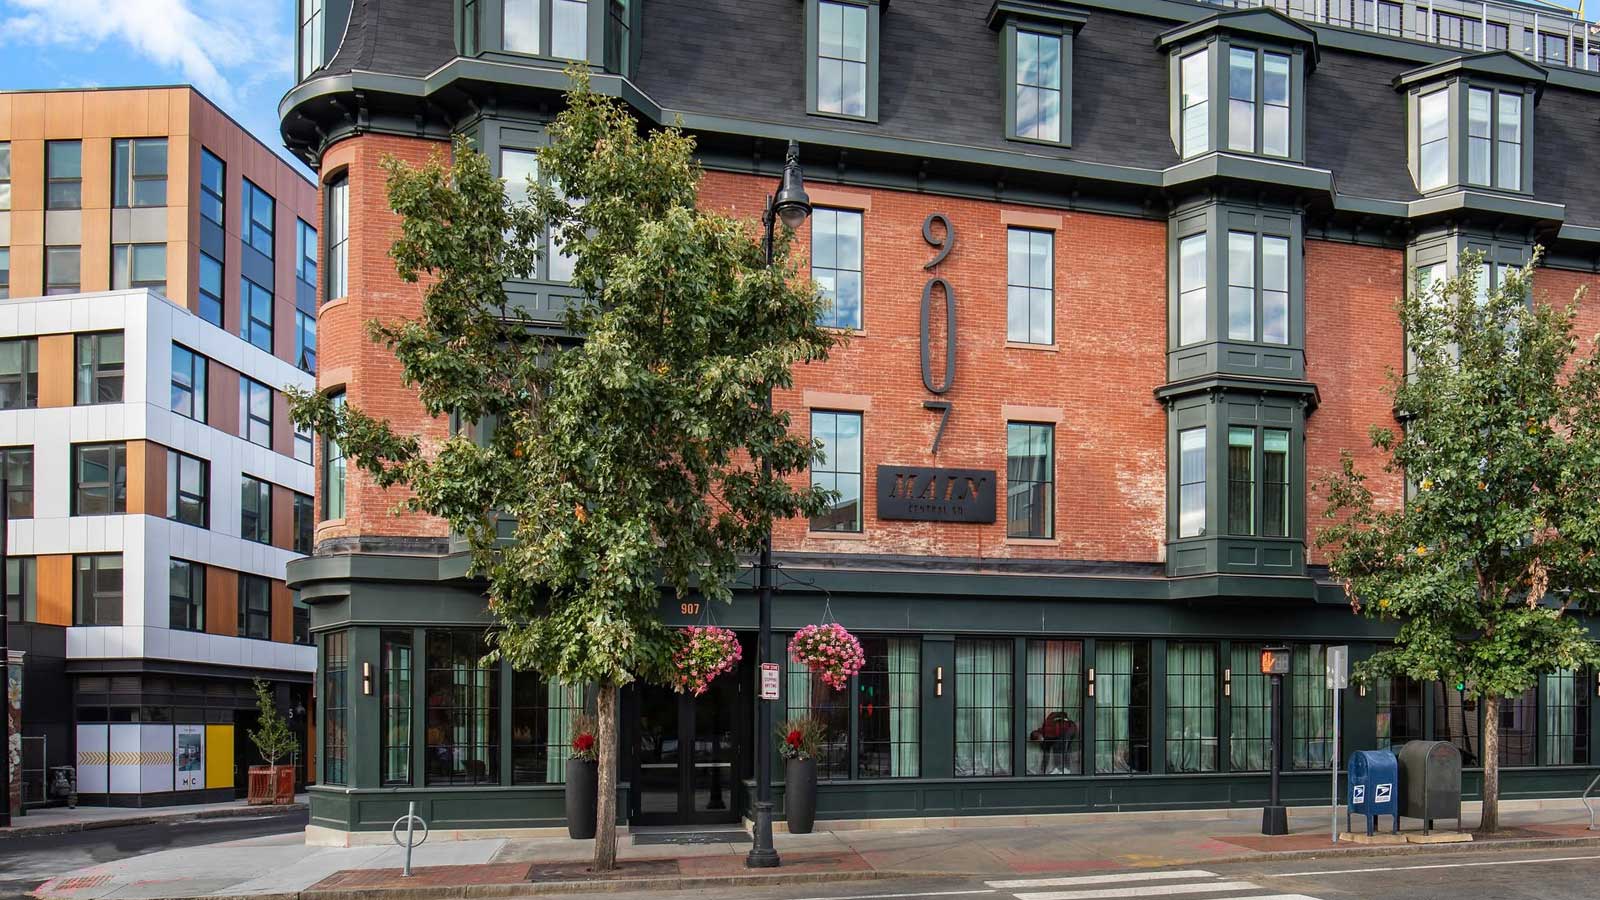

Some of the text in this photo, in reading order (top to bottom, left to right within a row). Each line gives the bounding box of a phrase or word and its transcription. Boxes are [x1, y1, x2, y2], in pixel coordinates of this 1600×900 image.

[920, 213, 955, 454] 907
[888, 473, 987, 503] MAIN
[681, 603, 700, 614] 907
